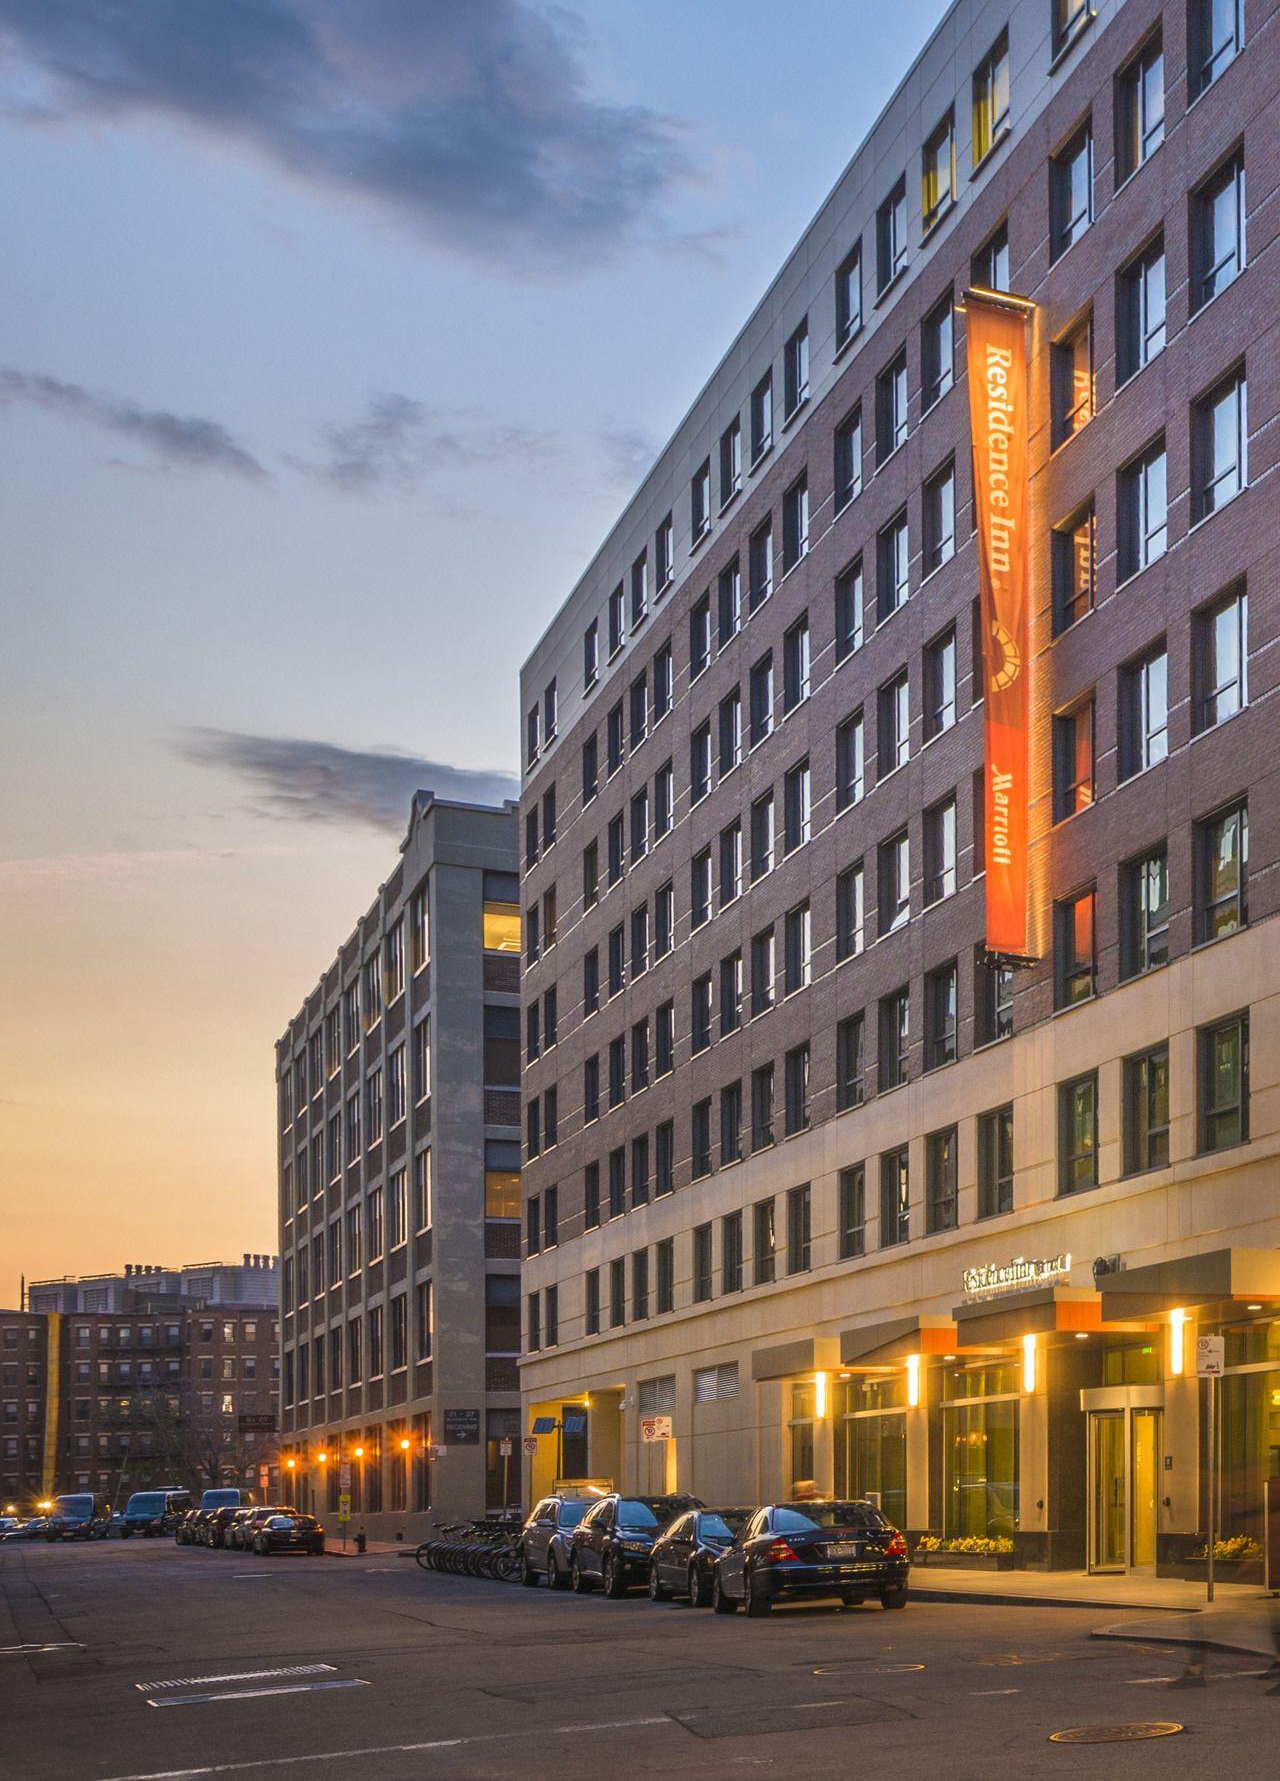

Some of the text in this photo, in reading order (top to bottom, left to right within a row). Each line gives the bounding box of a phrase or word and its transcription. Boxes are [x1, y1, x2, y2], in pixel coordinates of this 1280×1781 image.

[985, 343, 1015, 573] Residence Inn
[990, 764, 1012, 866] Marriott
